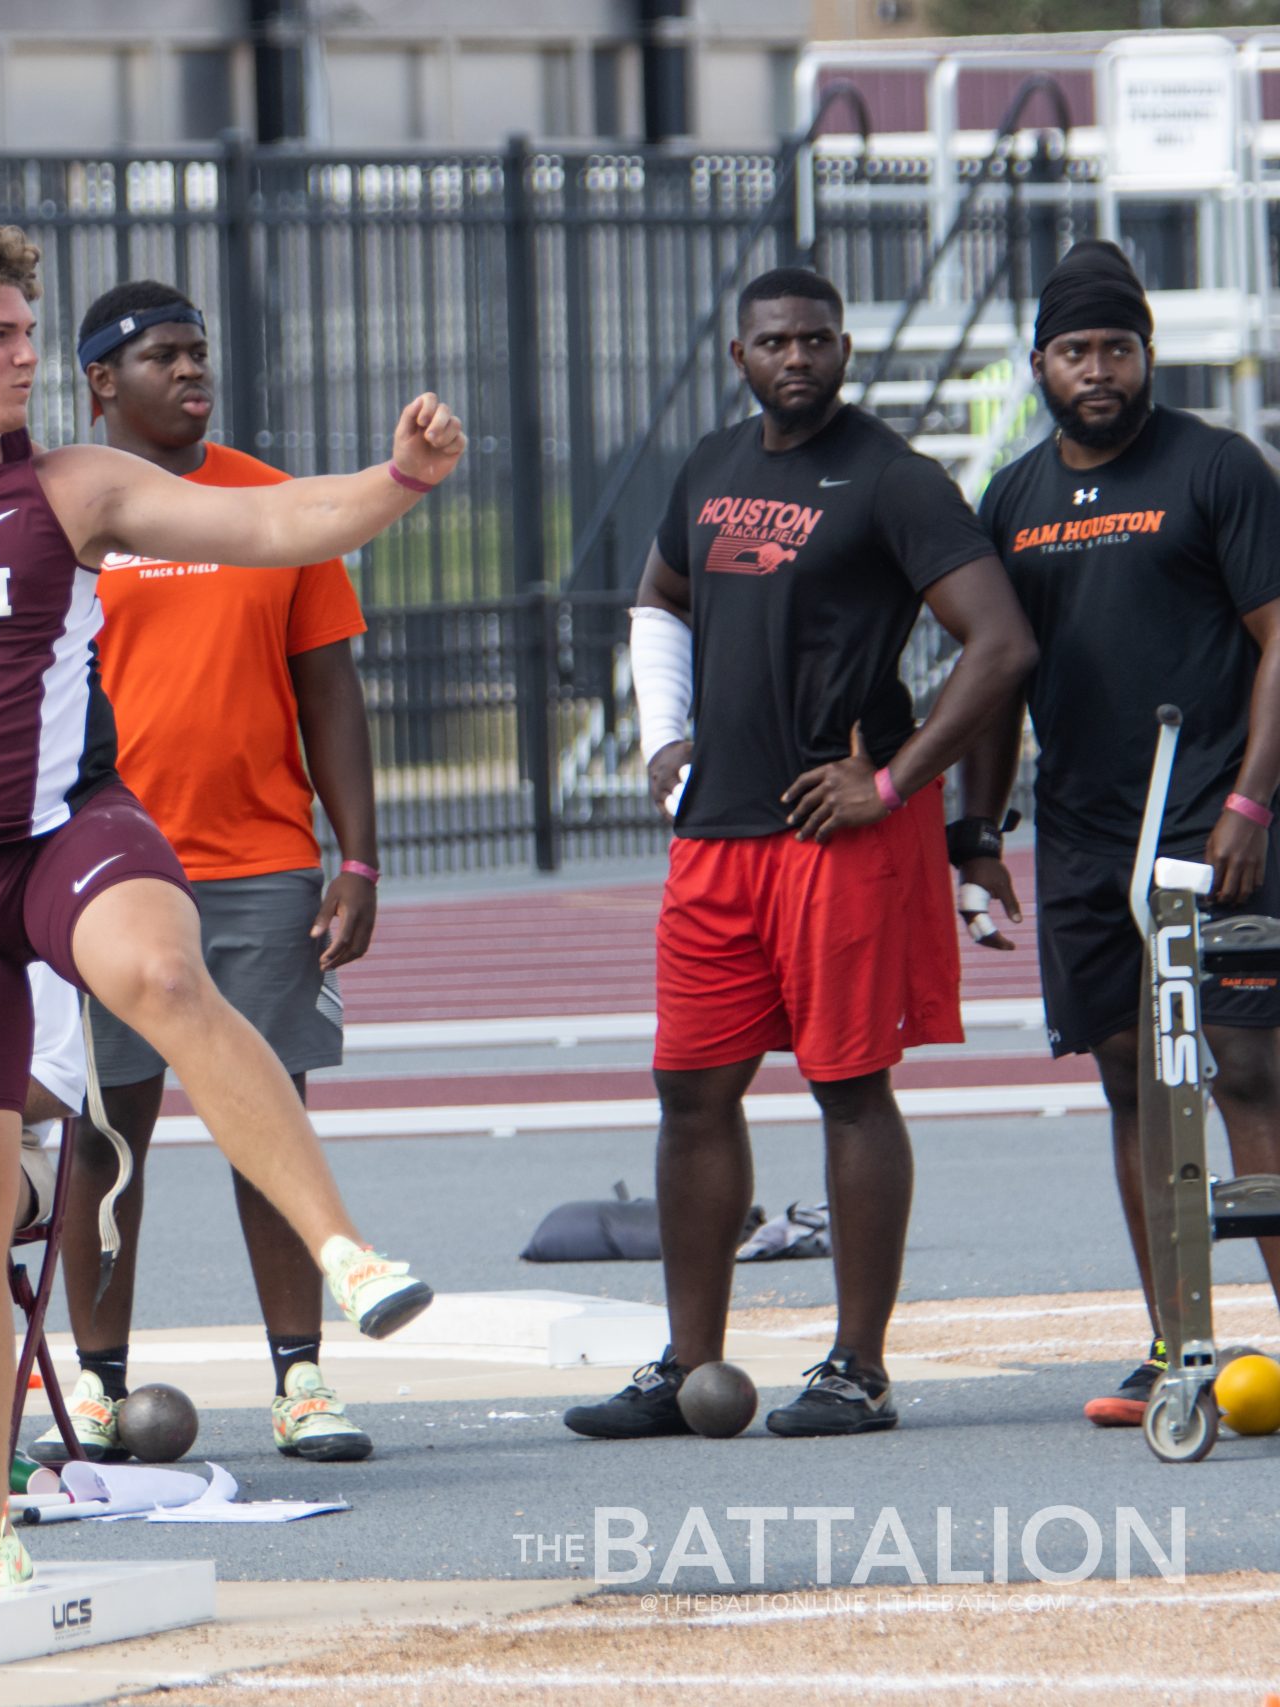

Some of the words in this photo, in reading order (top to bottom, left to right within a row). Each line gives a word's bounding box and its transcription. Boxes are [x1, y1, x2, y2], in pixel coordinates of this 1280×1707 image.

[696, 496, 824, 535] HOUSTON
[1013, 522, 1062, 552] SAM
[1061, 510, 1166, 542] HOUSTON
[1040, 541, 1084, 554] TRACK
[1096, 532, 1131, 546] FIELD
[139, 567, 174, 579] TRACK
[176, 565, 185, 576] &
[187, 563, 219, 574] FIELD
[1157, 925, 1199, 1087] UCS
[52, 1597, 92, 1630] UCS
